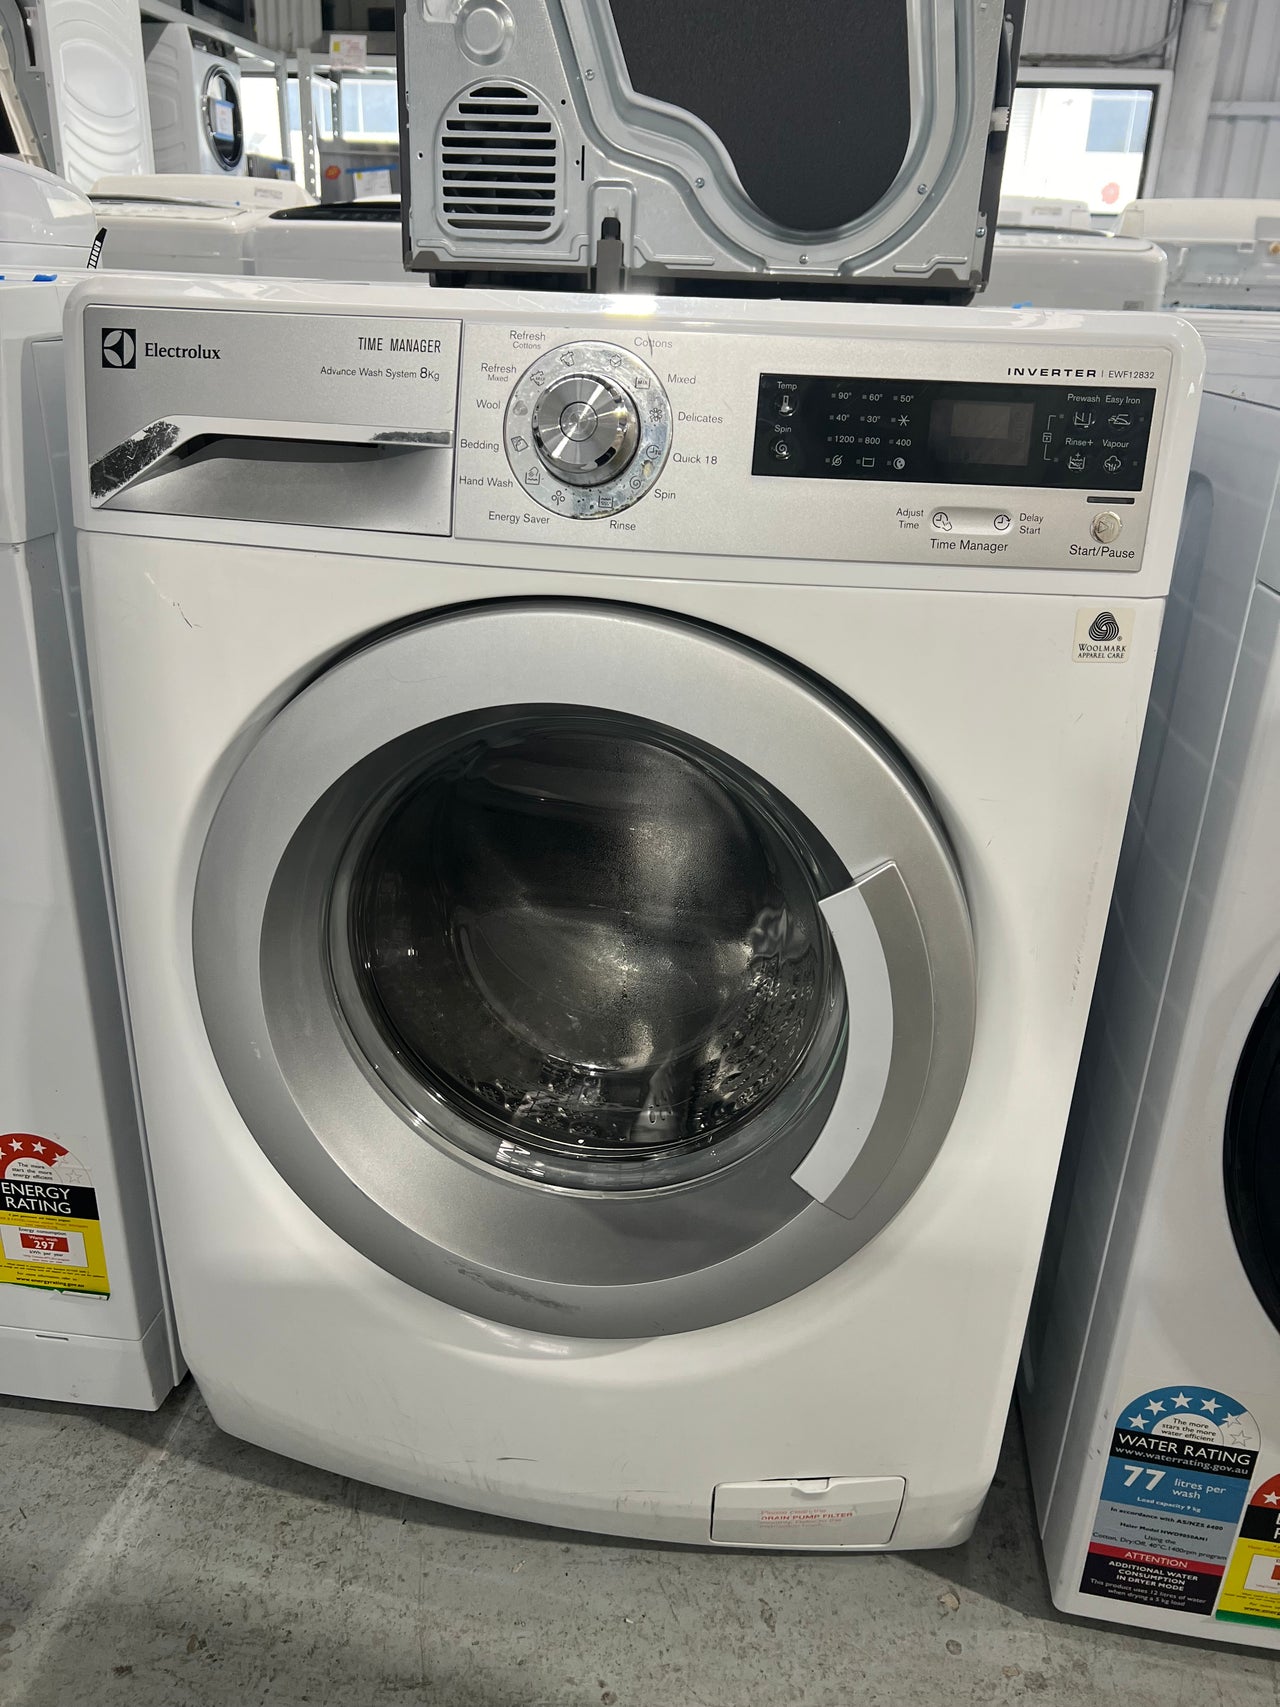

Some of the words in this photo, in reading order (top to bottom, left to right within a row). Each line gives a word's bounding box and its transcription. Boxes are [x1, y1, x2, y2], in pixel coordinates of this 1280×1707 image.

[509, 330, 546, 342] Refresh
[358, 336, 383, 351] TIME
[390, 338, 441, 354] MANAGER
[512, 341, 541, 350] Cottons
[634, 336, 673, 349] Cottons
[144, 342, 221, 361] Electrolux
[320, 365, 357, 377] Advance
[358, 366, 383, 378] Wash
[385, 367, 417, 380] System
[419, 366, 440, 382] 8Kg
[481, 362, 517, 374] Refresh
[1007, 367, 1097, 378] INVERTER
[1108, 370, 1155, 379] EWF12832
[487, 373, 509, 383] Mixed
[667, 373, 697, 385] Mixed
[777, 381, 797, 391] Temp
[838, 392, 852, 400] 90°
[900, 394, 914, 403] 50°
[1067, 393, 1100, 403] Prewash
[1105, 395, 1123, 405] Easy
[1125, 396, 1141, 404] Iron
[476, 399, 501, 410] Wool
[678, 411, 724, 424] Delicates
[774, 425, 792, 434] Spin
[460, 438, 500, 452] Bedding
[834, 435, 855, 443] 1200
[864, 437, 881, 445] 800
[895, 438, 912, 446] 400
[1065, 437, 1094, 447] Rinse+
[1102, 439, 1130, 449] Vapour
[673, 453, 701, 465] Quick
[705, 456, 718, 465] 18
[459, 476, 485, 487] Hand
[487, 478, 514, 488] Wash
[654, 489, 676, 501] Spin
[488, 511, 521, 524] Energy
[523, 513, 550, 525] Saver
[896, 508, 924, 519] Adjust
[1019, 513, 1044, 524] Delay
[609, 520, 636, 531] Rinse
[898, 520, 919, 530] Time
[1019, 525, 1041, 535] Start
[930, 538, 956, 550] Time
[959, 540, 1009, 554] Manager
[1069, 544, 1135, 559] Start/Pause
[1078, 643, 1127, 652] WOOLMARK
[1, 1182, 70, 1200] ENERGY
[5, 1196, 71, 1214] RATING
[34, 1240, 55, 1250] 297
[1162, 1423, 1180, 1431] stars
[1196, 1429, 1217, 1437] more
[1189, 1421, 1209, 1429] more
[1161, 1429, 1183, 1437] water
[1184, 1432, 1215, 1443] efficient
[1118, 1433, 1178, 1454] WATER
[1183, 1445, 1251, 1466] RATING
[1115, 1446, 1249, 1475] www.waterrating.gov.au
[1123, 1465, 1166, 1491] 77
[1174, 1478, 1202, 1491] litres
[1205, 1485, 1226, 1494] per
[1172, 1489, 1201, 1500] wash
[1137, 1497, 1155, 1505] Load
[1156, 1500, 1185, 1510] capacity
[1119, 1509, 1158, 1520] accordance
[1176, 1519, 1205, 1528] AS/NZS
[1125, 1551, 1188, 1568] ATTENTION
[1108, 1560, 1165, 1576] ADDITIONAL
[1167, 1570, 1199, 1581] WATER
[1118, 1568, 1186, 1585] CONSUMPTION
[1128, 1576, 1156, 1587] DRYER
[1158, 1582, 1185, 1592] MODE
